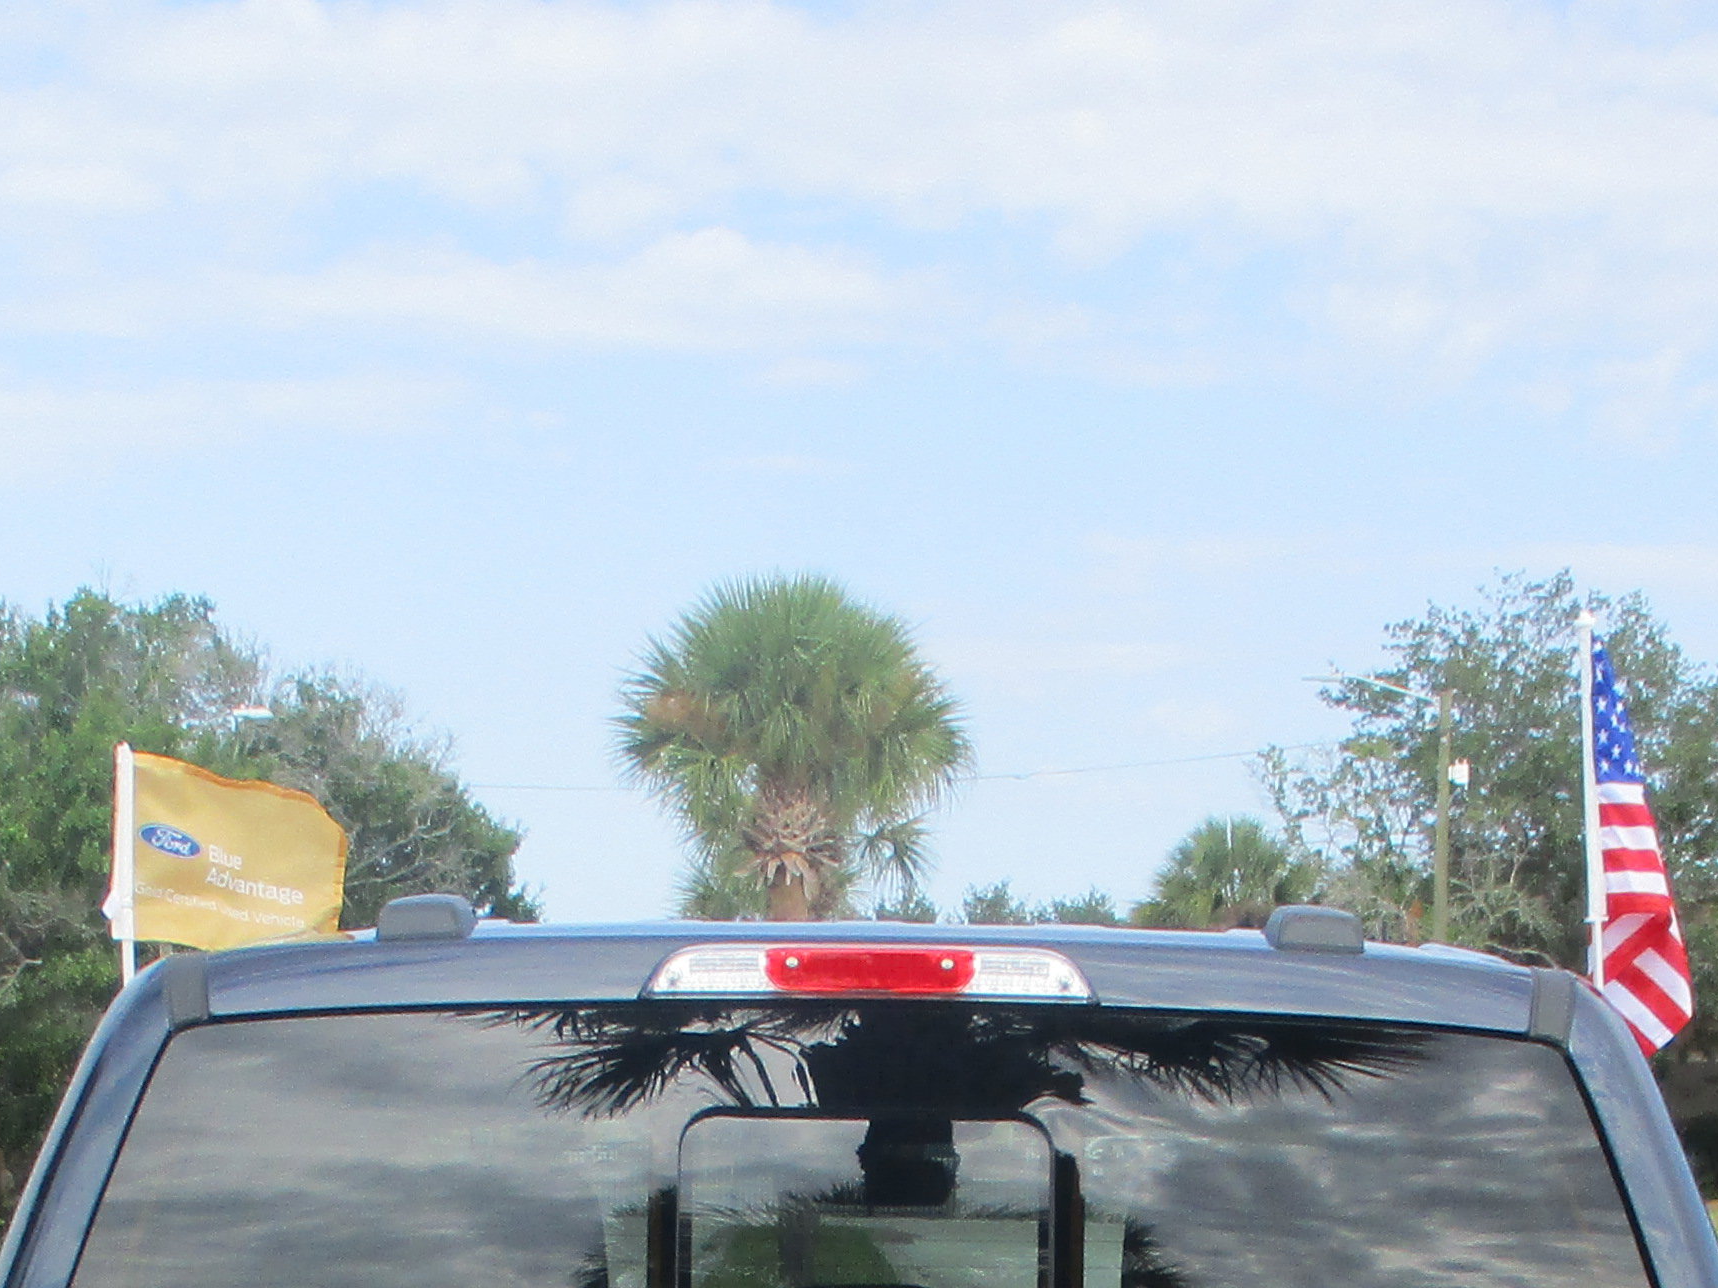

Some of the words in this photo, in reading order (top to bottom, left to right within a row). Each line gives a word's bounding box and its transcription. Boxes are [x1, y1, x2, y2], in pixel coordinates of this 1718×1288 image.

[149, 827, 194, 856] Ford
[208, 844, 243, 870] Blue
[205, 868, 305, 906] Advantage
